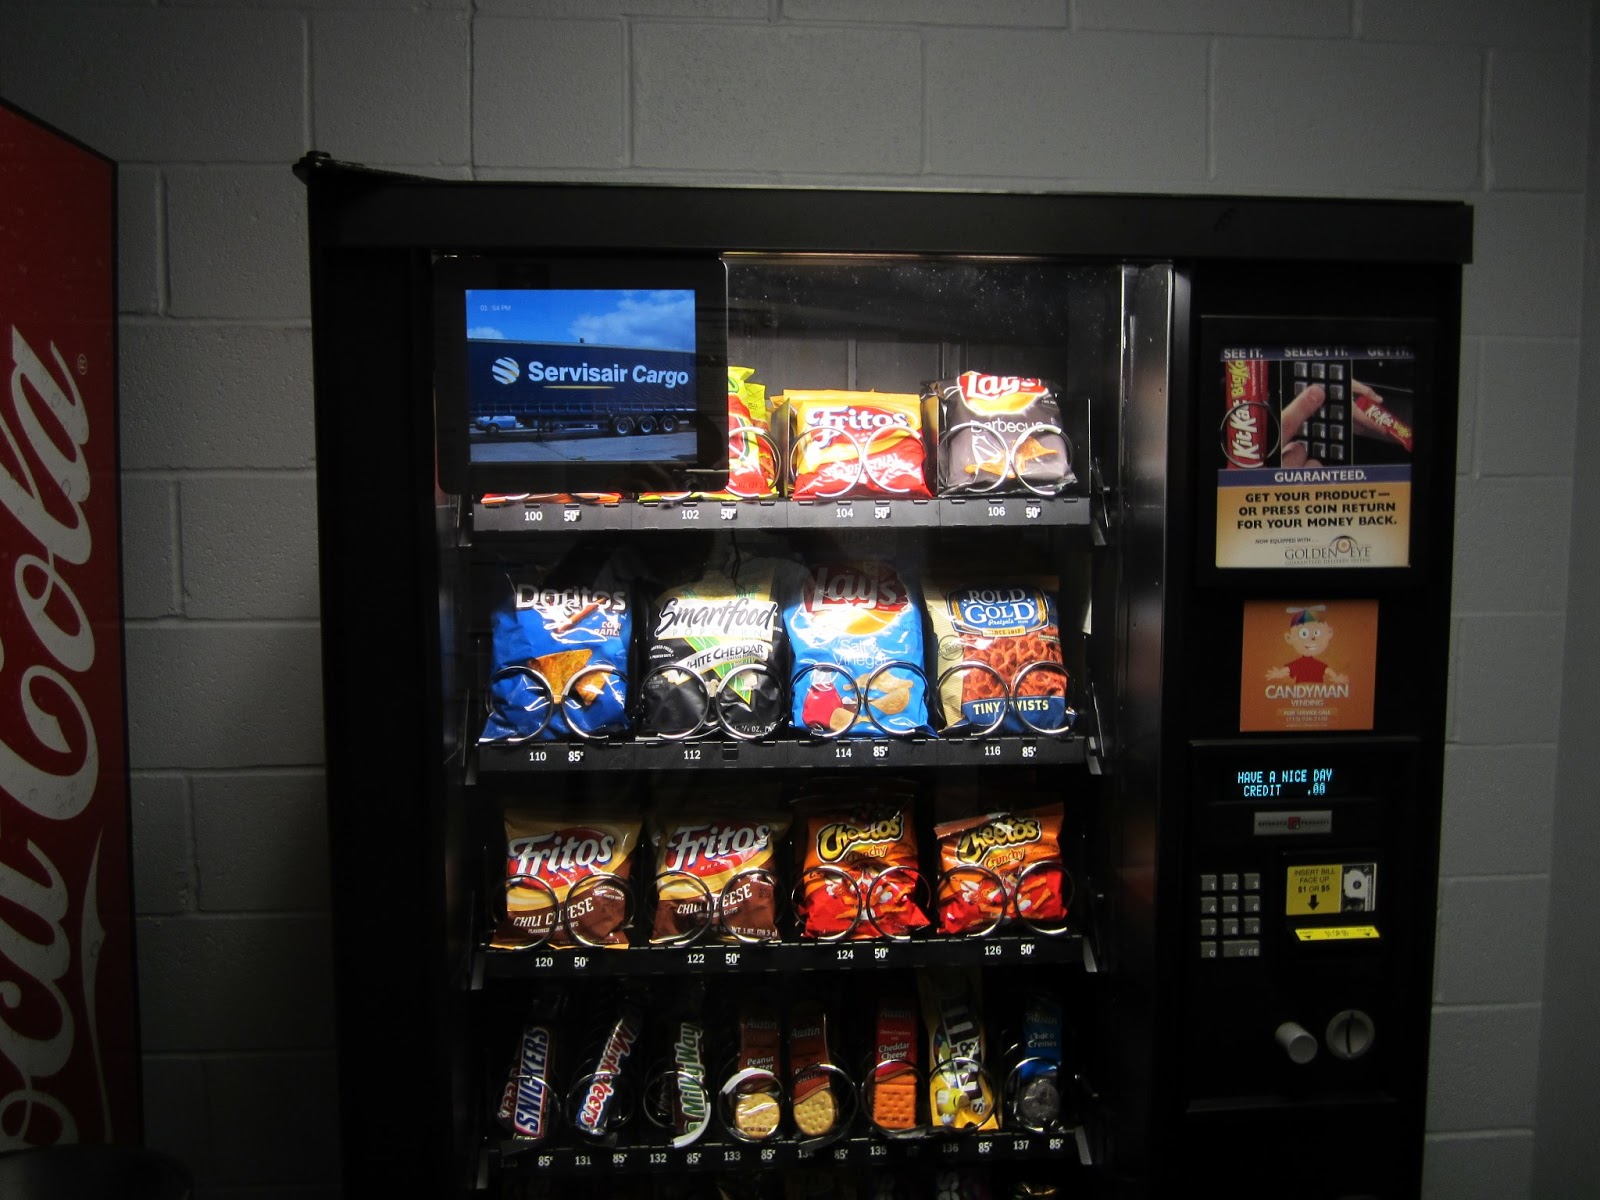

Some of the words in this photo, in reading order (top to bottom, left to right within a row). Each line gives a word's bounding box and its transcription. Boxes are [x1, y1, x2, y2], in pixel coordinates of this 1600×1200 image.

[1224, 348, 1248, 358] SEE
[1284, 347, 1330, 357] SELECT
[1368, 347, 1389, 357] GET
[528, 360, 628, 383] Servisair
[632, 364, 689, 388] Cargo
[966, 375, 1036, 401] Lays
[805, 406, 909, 450] Fritos
[1274, 471, 1367, 483] GUARANTEED.
[1246, 493, 1270, 502] GET
[1274, 492, 1310, 502] YOUR
[836, 508, 854, 518] 104
[988, 507, 1006, 517] 106
[1239, 506, 1256, 516] OR
[1262, 505, 1300, 515] PRESS
[1305, 504, 1337, 514] COIN
[1342, 502, 1396, 513] RETURN
[524, 511, 542, 521] 100
[681, 510, 699, 520] 102
[1238, 520, 1262, 529] FOR
[1266, 519, 1302, 528] YOUR
[1307, 517, 1354, 528] MONEY
[1359, 516, 1397, 526] BACK.
[1284, 548, 1338, 560] GOLDEN
[1350, 546, 1372, 558] EYE
[516, 583, 626, 611] Doritos
[968, 588, 1026, 606] ROLD
[654, 596, 778, 638] Smartfood
[964, 602, 1034, 624] GOLD
[686, 652, 712, 669] HITE
[714, 644, 764, 660] CHEDDAR
[833, 654, 887, 669] Vinegar
[1265, 685, 1349, 699] CANDYMAN
[973, 701, 1001, 715] TINY
[529, 751, 547, 762] 110
[684, 750, 700, 760] 112
[835, 748, 852, 758] 114
[985, 746, 1000, 756] 116
[1238, 771, 1263, 784] HAVE
[1269, 770, 1276, 783] A
[1282, 769, 1307, 783] NICE
[1313, 768, 1333, 782] DAY
[1244, 784, 1282, 797] CREDIT
[820, 817, 901, 860] Cheetos
[958, 818, 1038, 864] Cheetos
[667, 825, 770, 872] Fritos
[508, 833, 614, 876] Fritos
[985, 848, 1025, 869] Crunchy
[513, 914, 542, 927] CHILI
[546, 897, 594, 925] CESE
[836, 950, 854, 960] 124
[984, 945, 1002, 955] 126
[535, 957, 553, 967] 120
[687, 954, 705, 964] 122
[791, 1027, 820, 1038] Austin
[878, 1042, 911, 1053] Cheddar
[747, 1056, 774, 1065] Peanut
[881, 1051, 907, 1060] Cheese
[516, 1026, 549, 1132] SNICKERS
[942, 1143, 959, 1153] 136
[1014, 1140, 1030, 1150] 137
[724, 1151, 741, 1161] 133
[870, 1146, 887, 1156] 135
[575, 1155, 592, 1166] 131
[650, 1153, 667, 1163] 132
